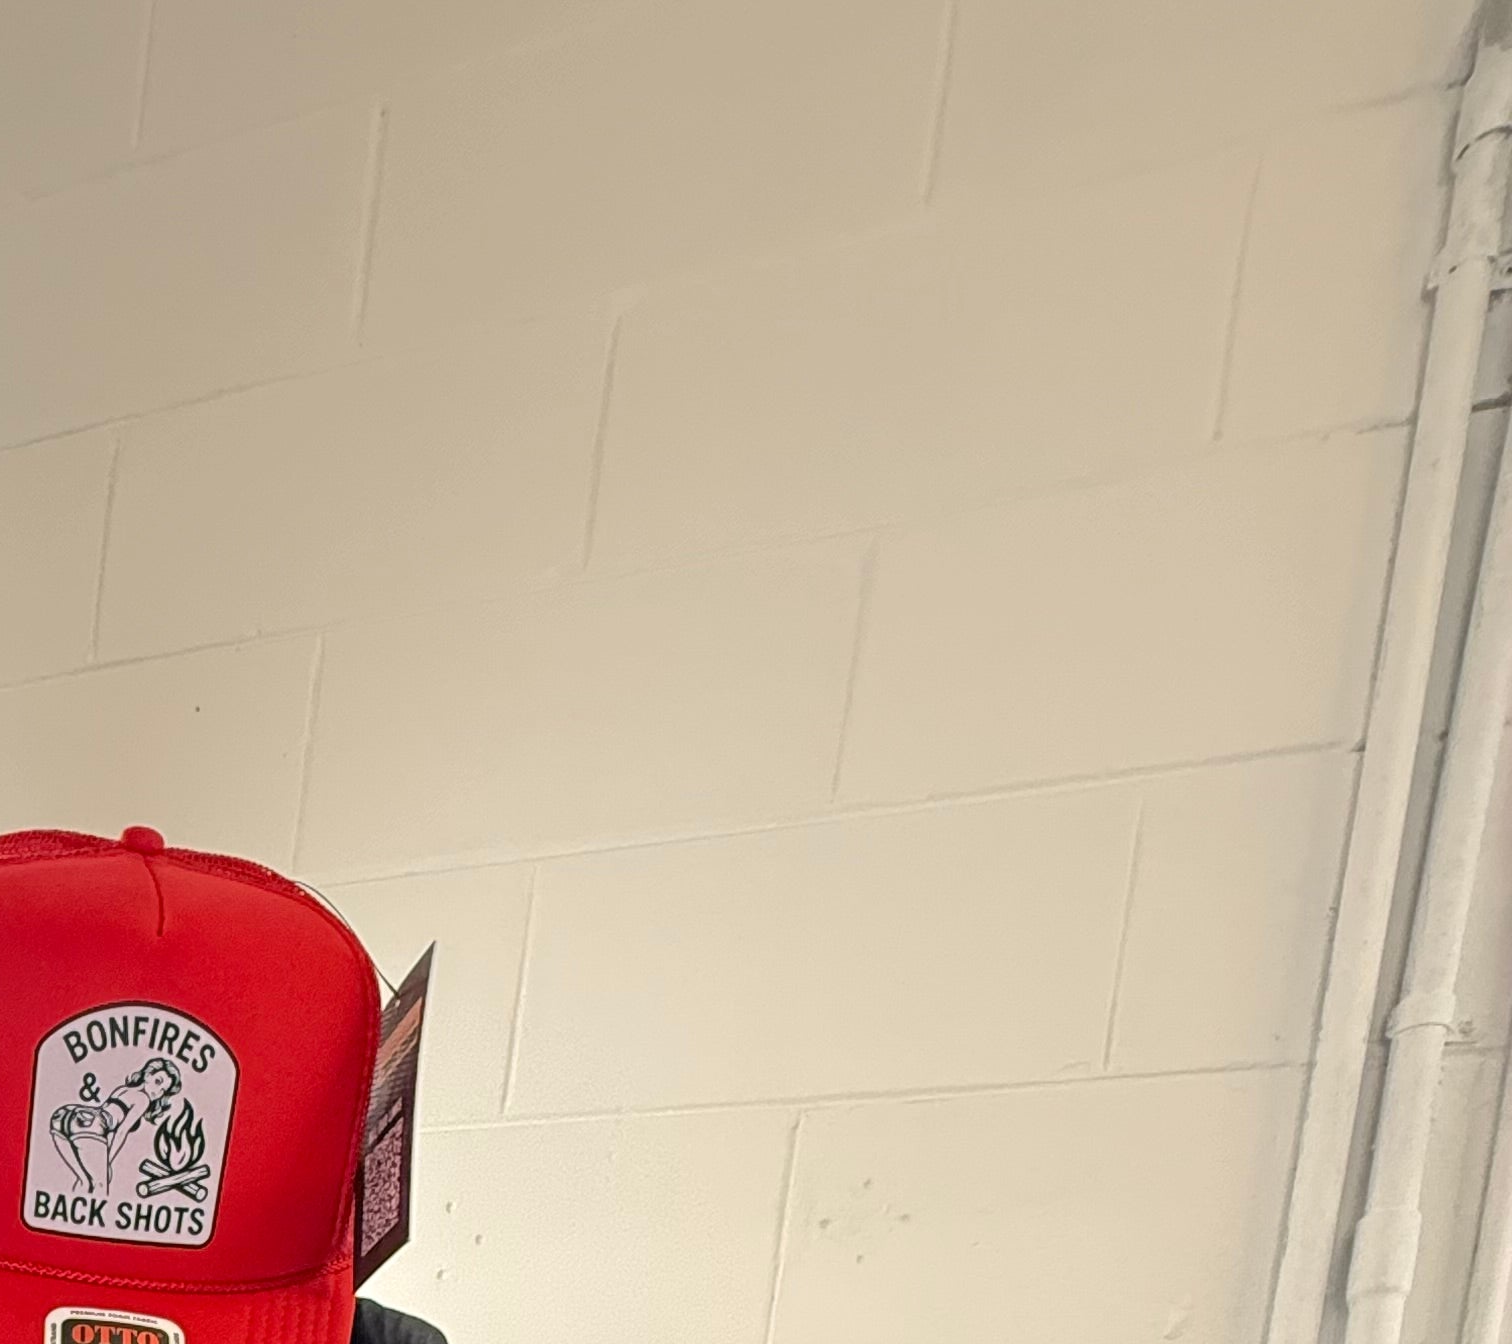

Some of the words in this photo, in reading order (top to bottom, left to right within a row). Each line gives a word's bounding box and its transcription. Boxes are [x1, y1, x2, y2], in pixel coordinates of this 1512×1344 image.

[63, 1015, 216, 1073] BONFIRES
[79, 1072, 101, 1103] &
[34, 1190, 108, 1227] BACK
[115, 1201, 205, 1235] SHOTS
